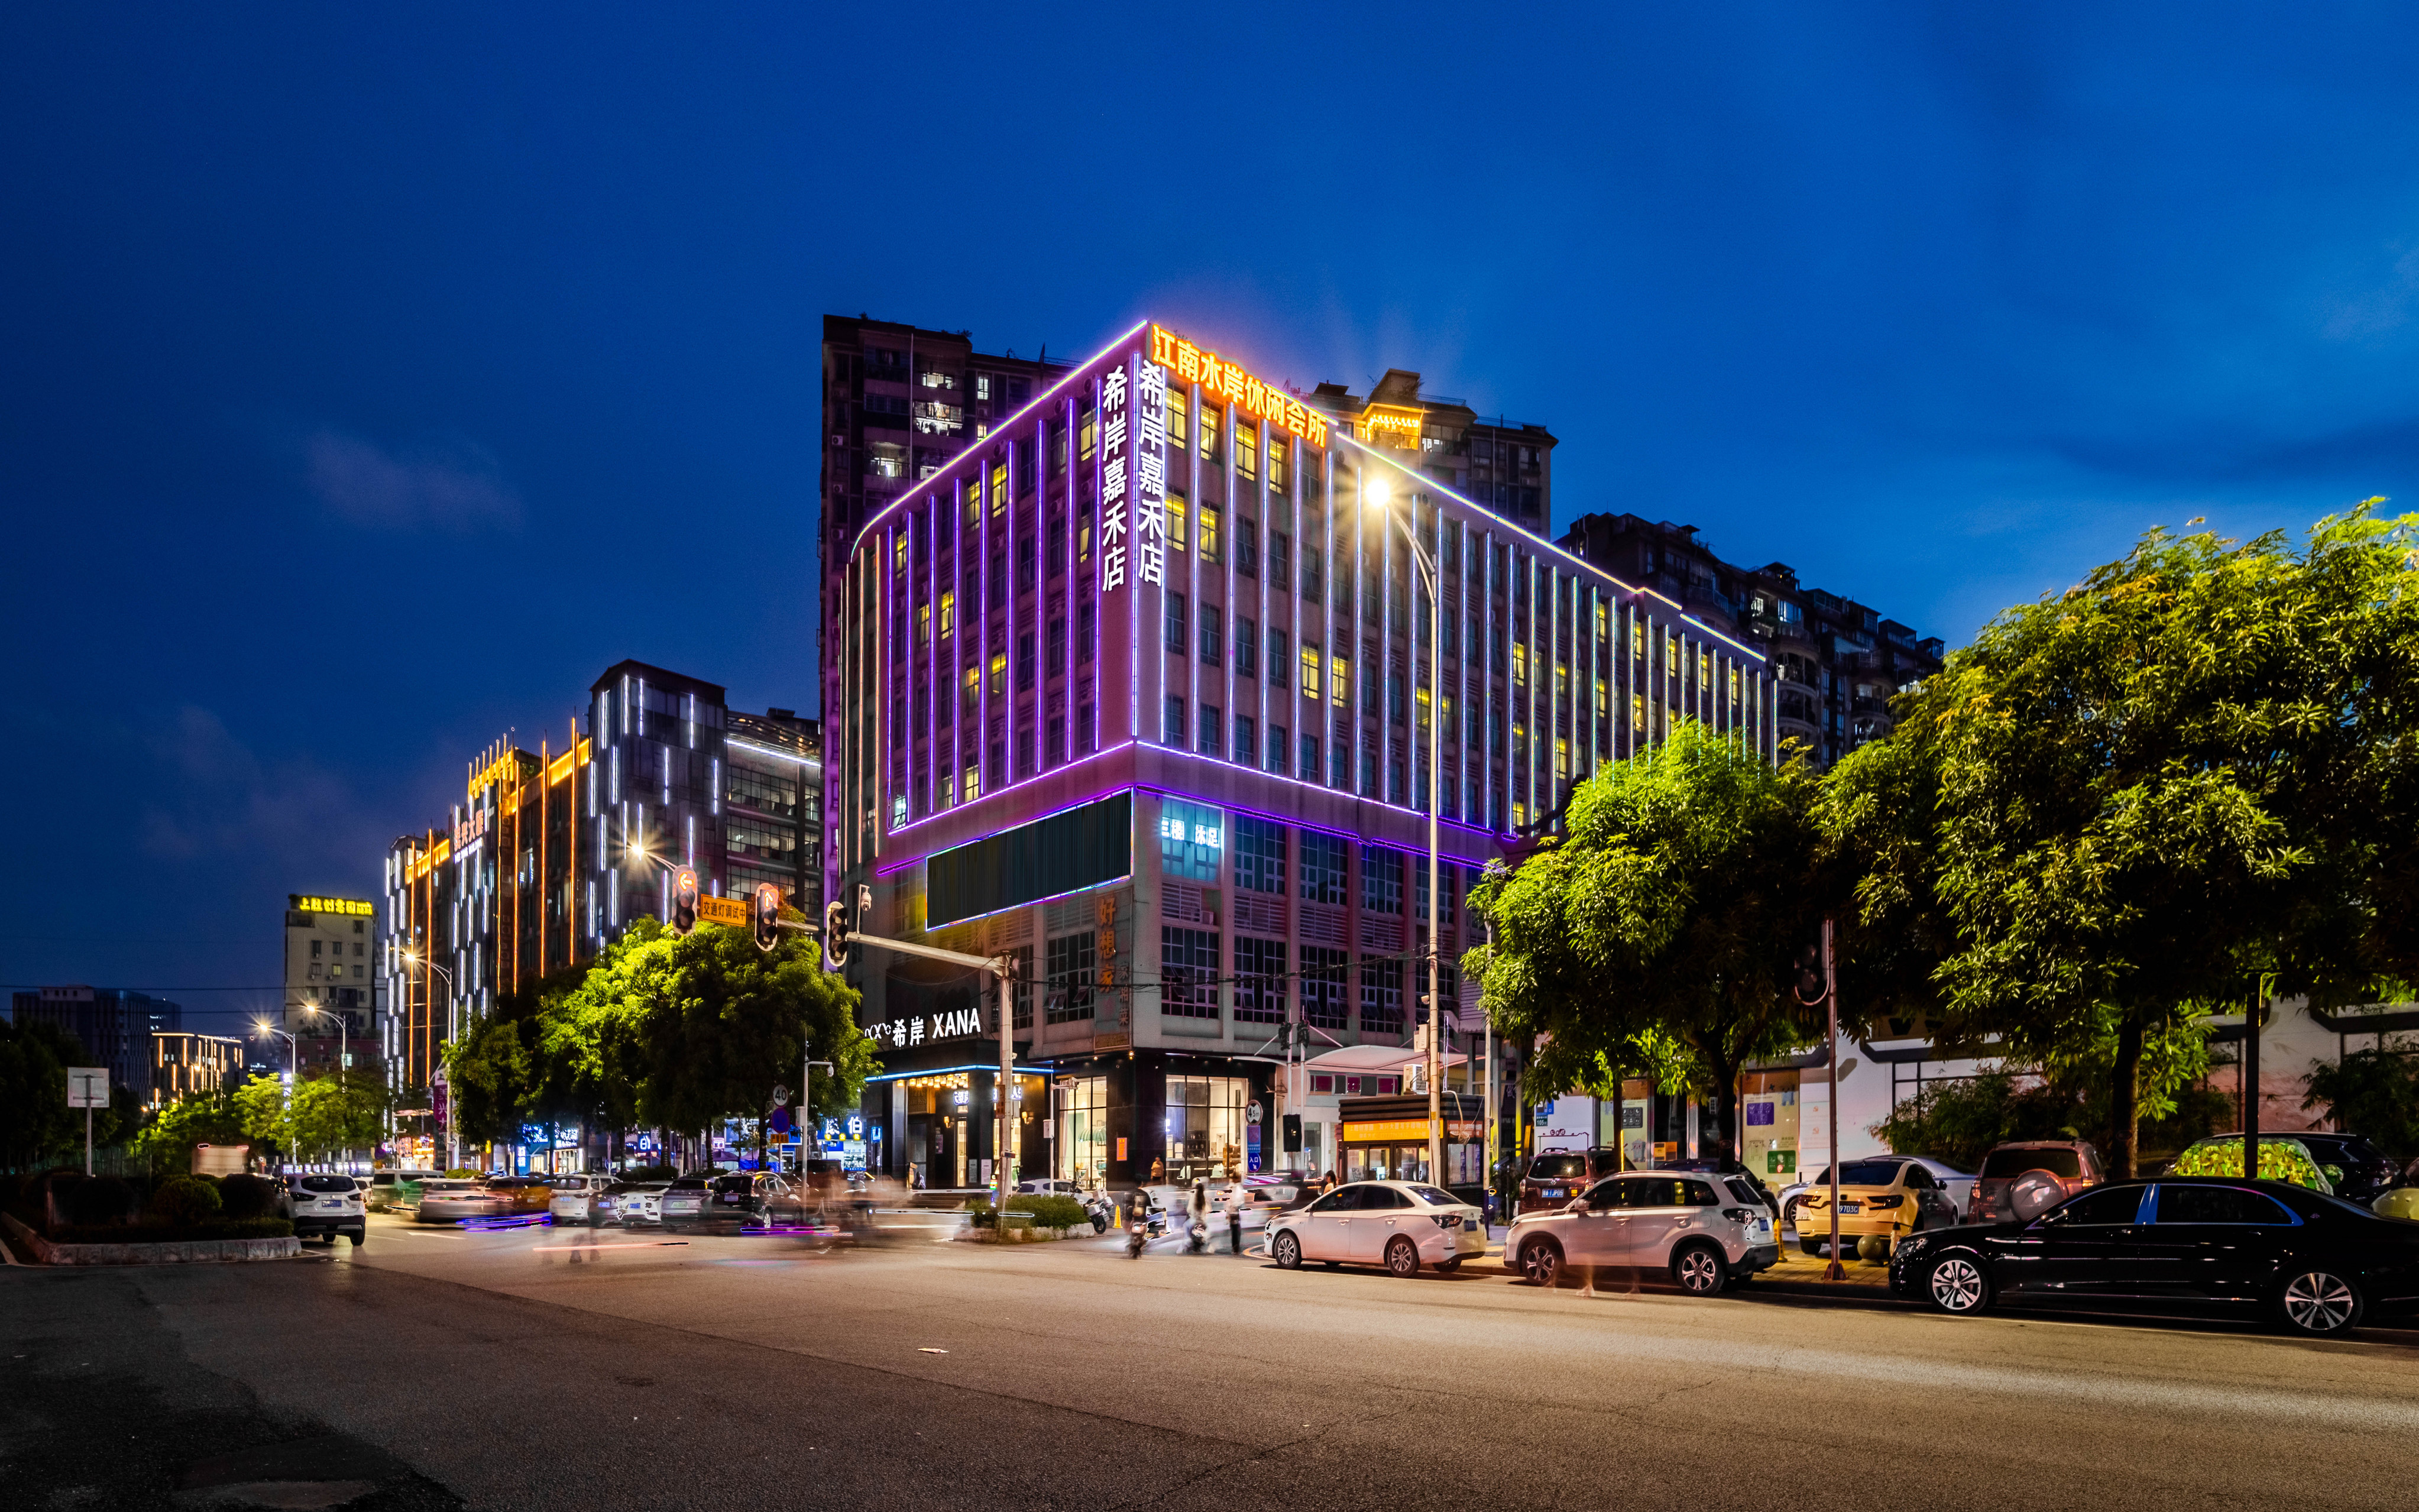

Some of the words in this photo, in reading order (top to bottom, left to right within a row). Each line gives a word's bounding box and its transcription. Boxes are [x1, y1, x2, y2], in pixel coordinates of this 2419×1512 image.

[1152, 323, 1327, 448] 江南水岸休闲会所
[1102, 365, 1128, 591] 希岸嘉禾店
[1138, 360, 1164, 587] 希岸嘉禾店
[1161, 819, 1184, 840] 三楼
[1195, 824, 1220, 847] 沐足
[704, 901, 746, 921] 交通灯调试中
[1099, 896, 1116, 991] 好想家
[892, 1016, 925, 1048] 希岸
[932, 1008, 982, 1039] XANA
[775, 1089, 786, 1101] 40
